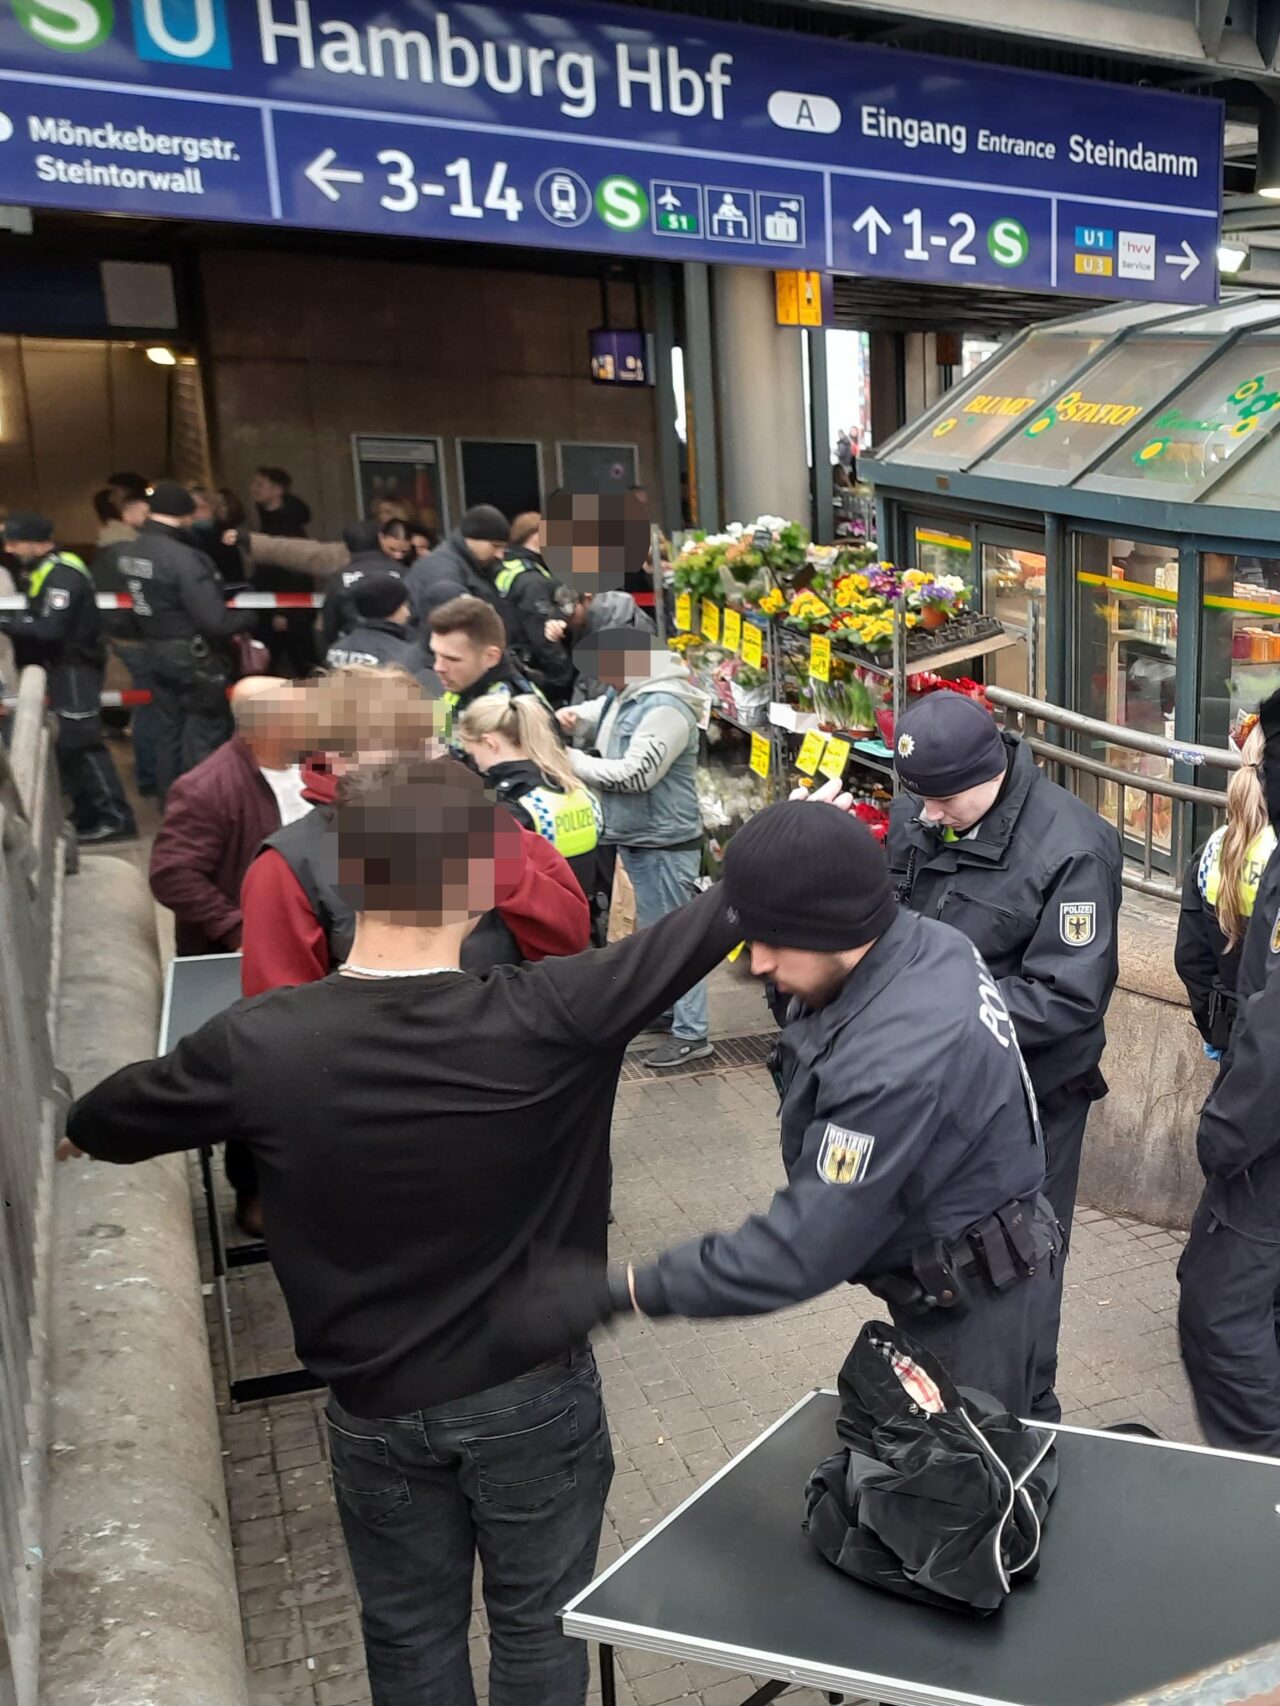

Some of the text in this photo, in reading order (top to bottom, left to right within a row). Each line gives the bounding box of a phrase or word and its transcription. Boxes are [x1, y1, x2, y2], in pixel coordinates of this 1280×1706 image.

[144, 0, 216, 58] U
[257, 0, 734, 121] Hamburg Hbf
[796, 98, 815, 127] A
[27, 115, 241, 163] Mönckebergstr.
[860, 105, 1199, 178] Eingang Entrance Steindamm
[34, 154, 205, 195] Steintorwall
[376, 149, 523, 222] 3-14
[602, 179, 642, 229] S
[667, 213, 689, 231] S1
[902, 207, 977, 266] 1-2
[992, 221, 1023, 264] S
[1084, 229, 1105, 248] U1
[1127, 241, 1152, 255] hvv
[1083, 257, 1105, 273] U3
[1121, 260, 1152, 271] Service
[554, 807, 596, 837] POLIZE
[1063, 905, 1093, 915] POLIZEI
